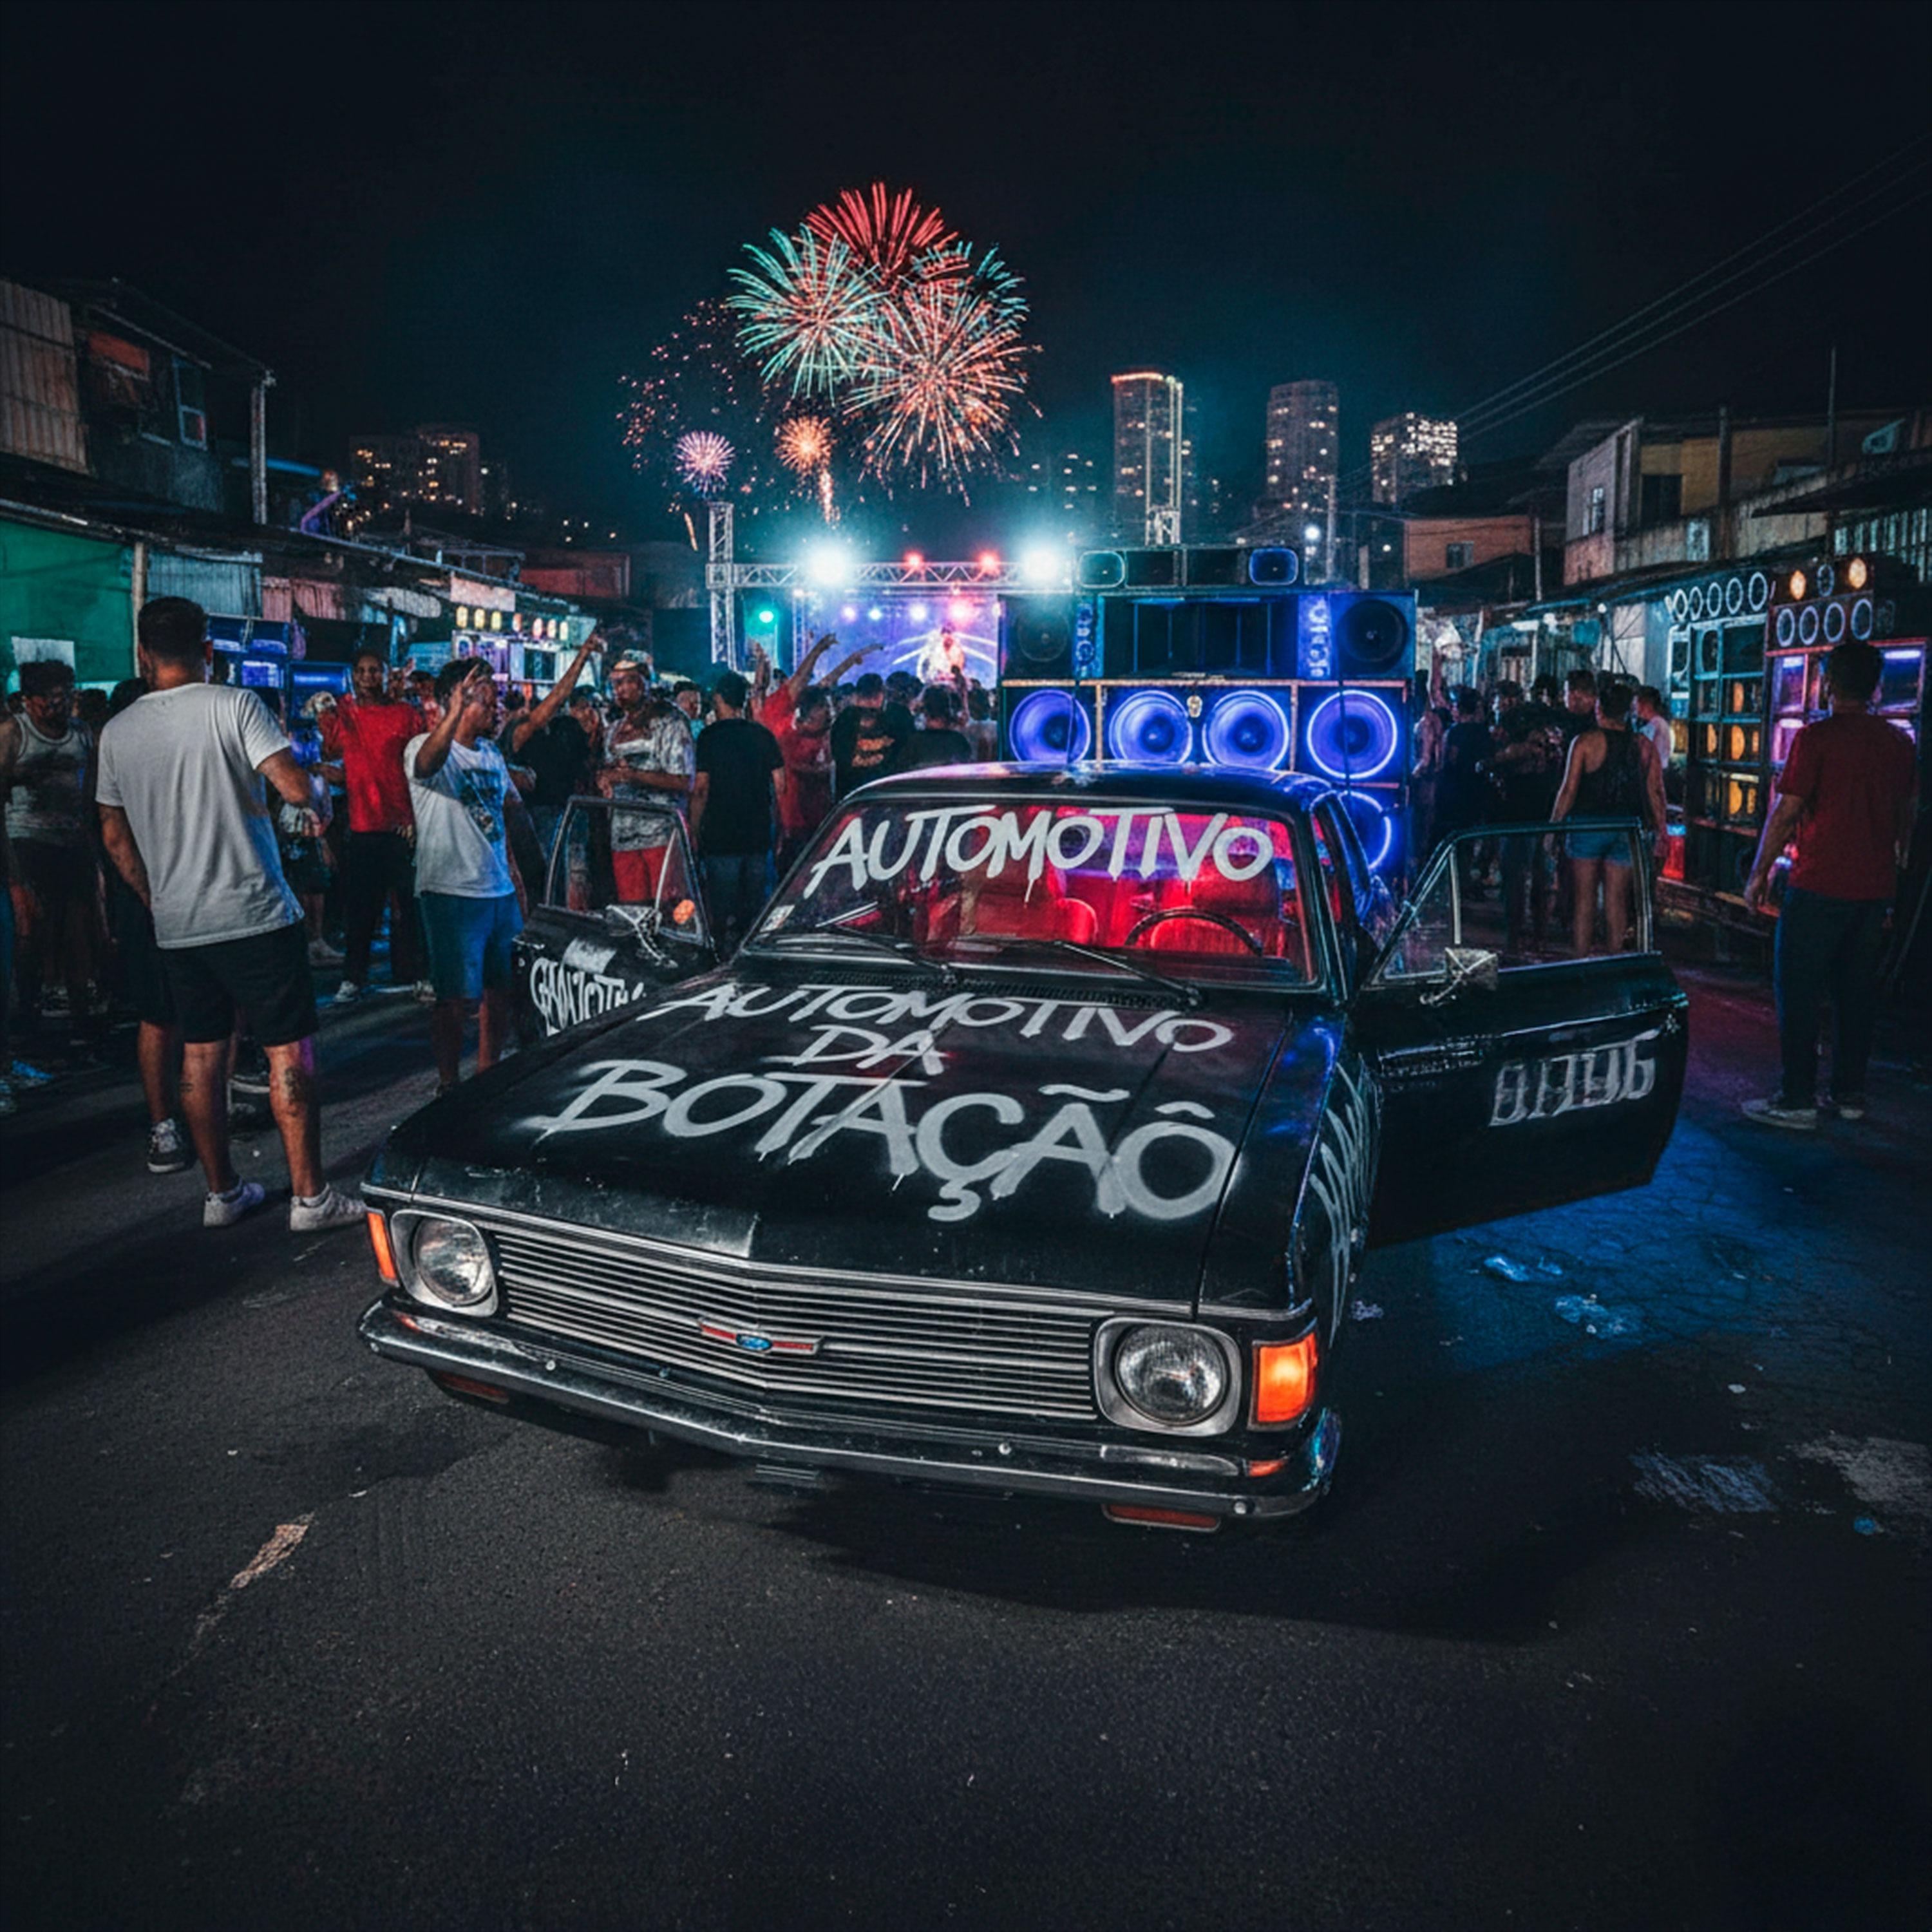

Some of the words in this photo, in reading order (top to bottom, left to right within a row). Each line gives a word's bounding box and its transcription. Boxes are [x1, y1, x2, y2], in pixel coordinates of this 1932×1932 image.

[804, 806, 1273, 900] AUTOMOTIVO
[636, 984, 1235, 1052] AUTOMOTIVO
[764, 1026, 947, 1074] DA
